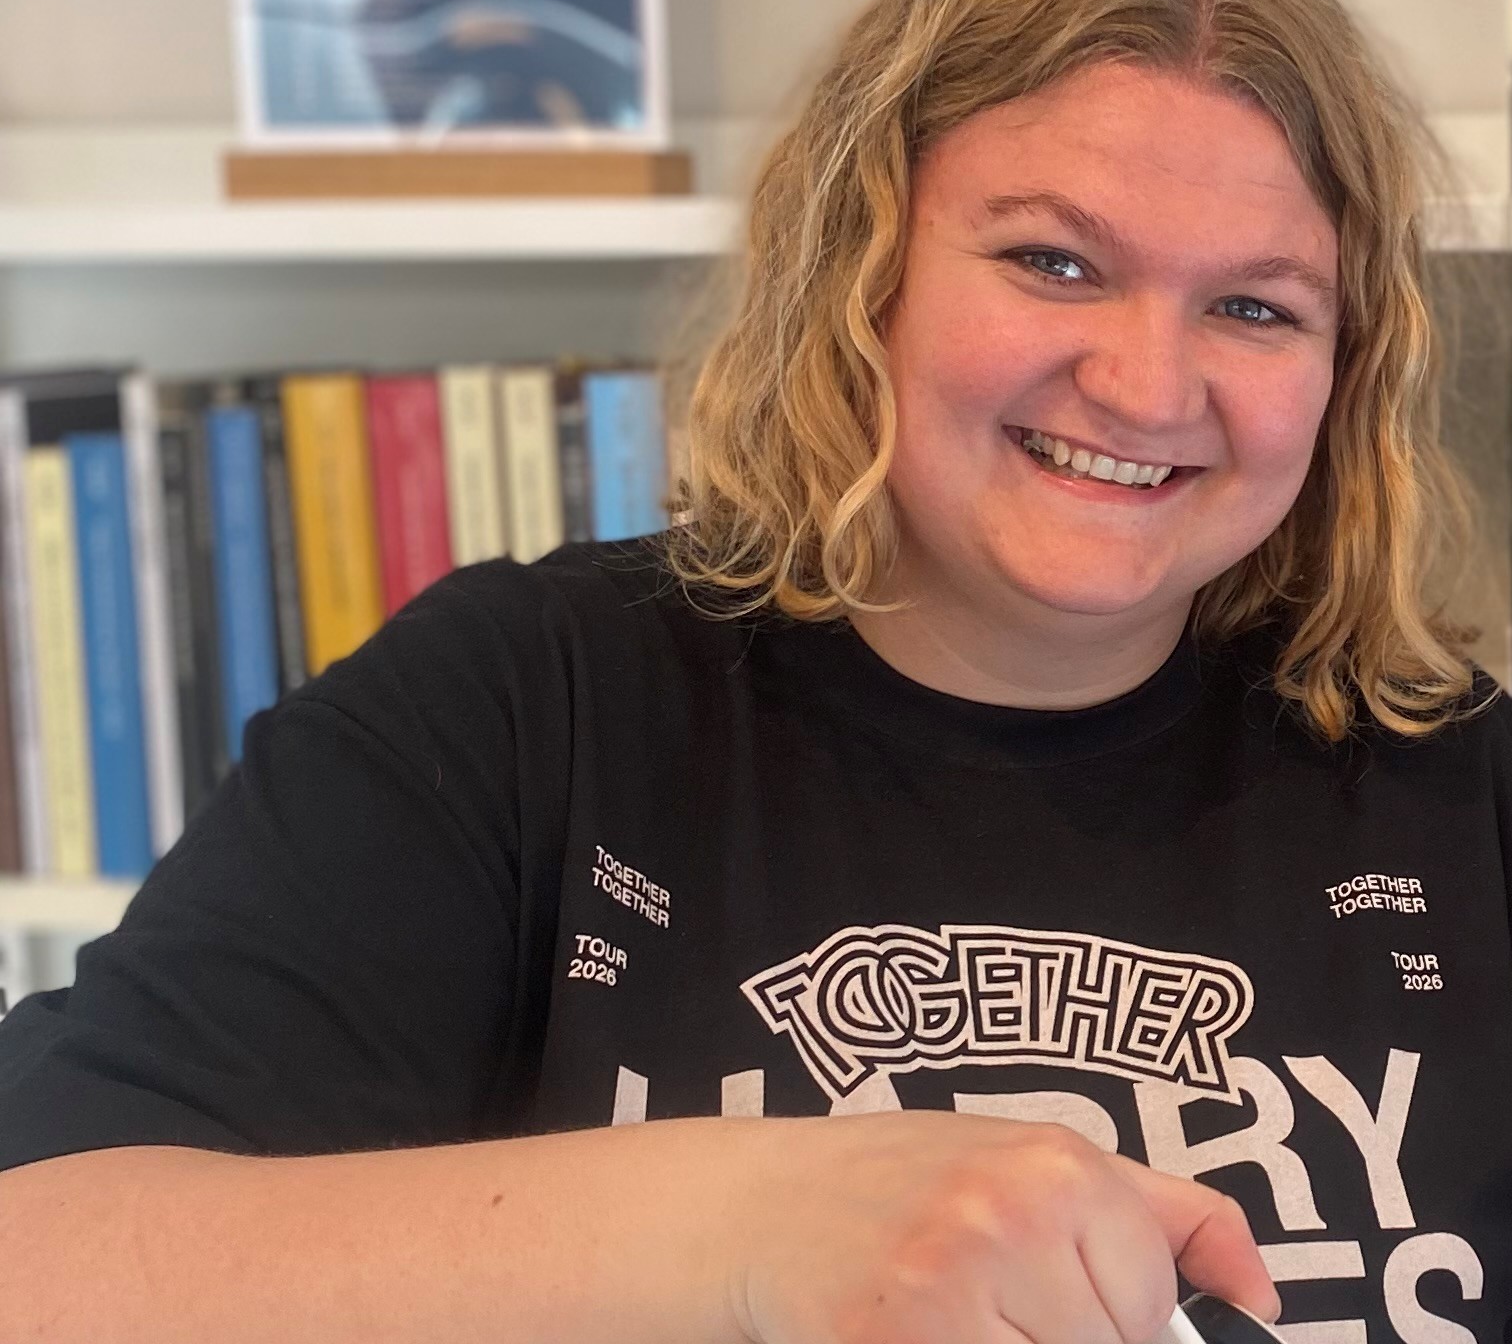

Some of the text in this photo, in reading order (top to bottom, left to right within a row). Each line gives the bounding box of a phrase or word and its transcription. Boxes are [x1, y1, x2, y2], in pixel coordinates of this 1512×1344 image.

[596, 845, 670, 908] TOGETHER
[1325, 874, 1423, 902] TOGETHER
[592, 867, 669, 928] TOGETHER
[1329, 893, 1427, 918] TOGETHER
[575, 935, 628, 969] TOUR
[1391, 951, 1439, 970] TOUR
[568, 958, 617, 986] 2026
[1402, 974, 1444, 990] 2026
[742, 924, 1254, 1102] TOGETHER
